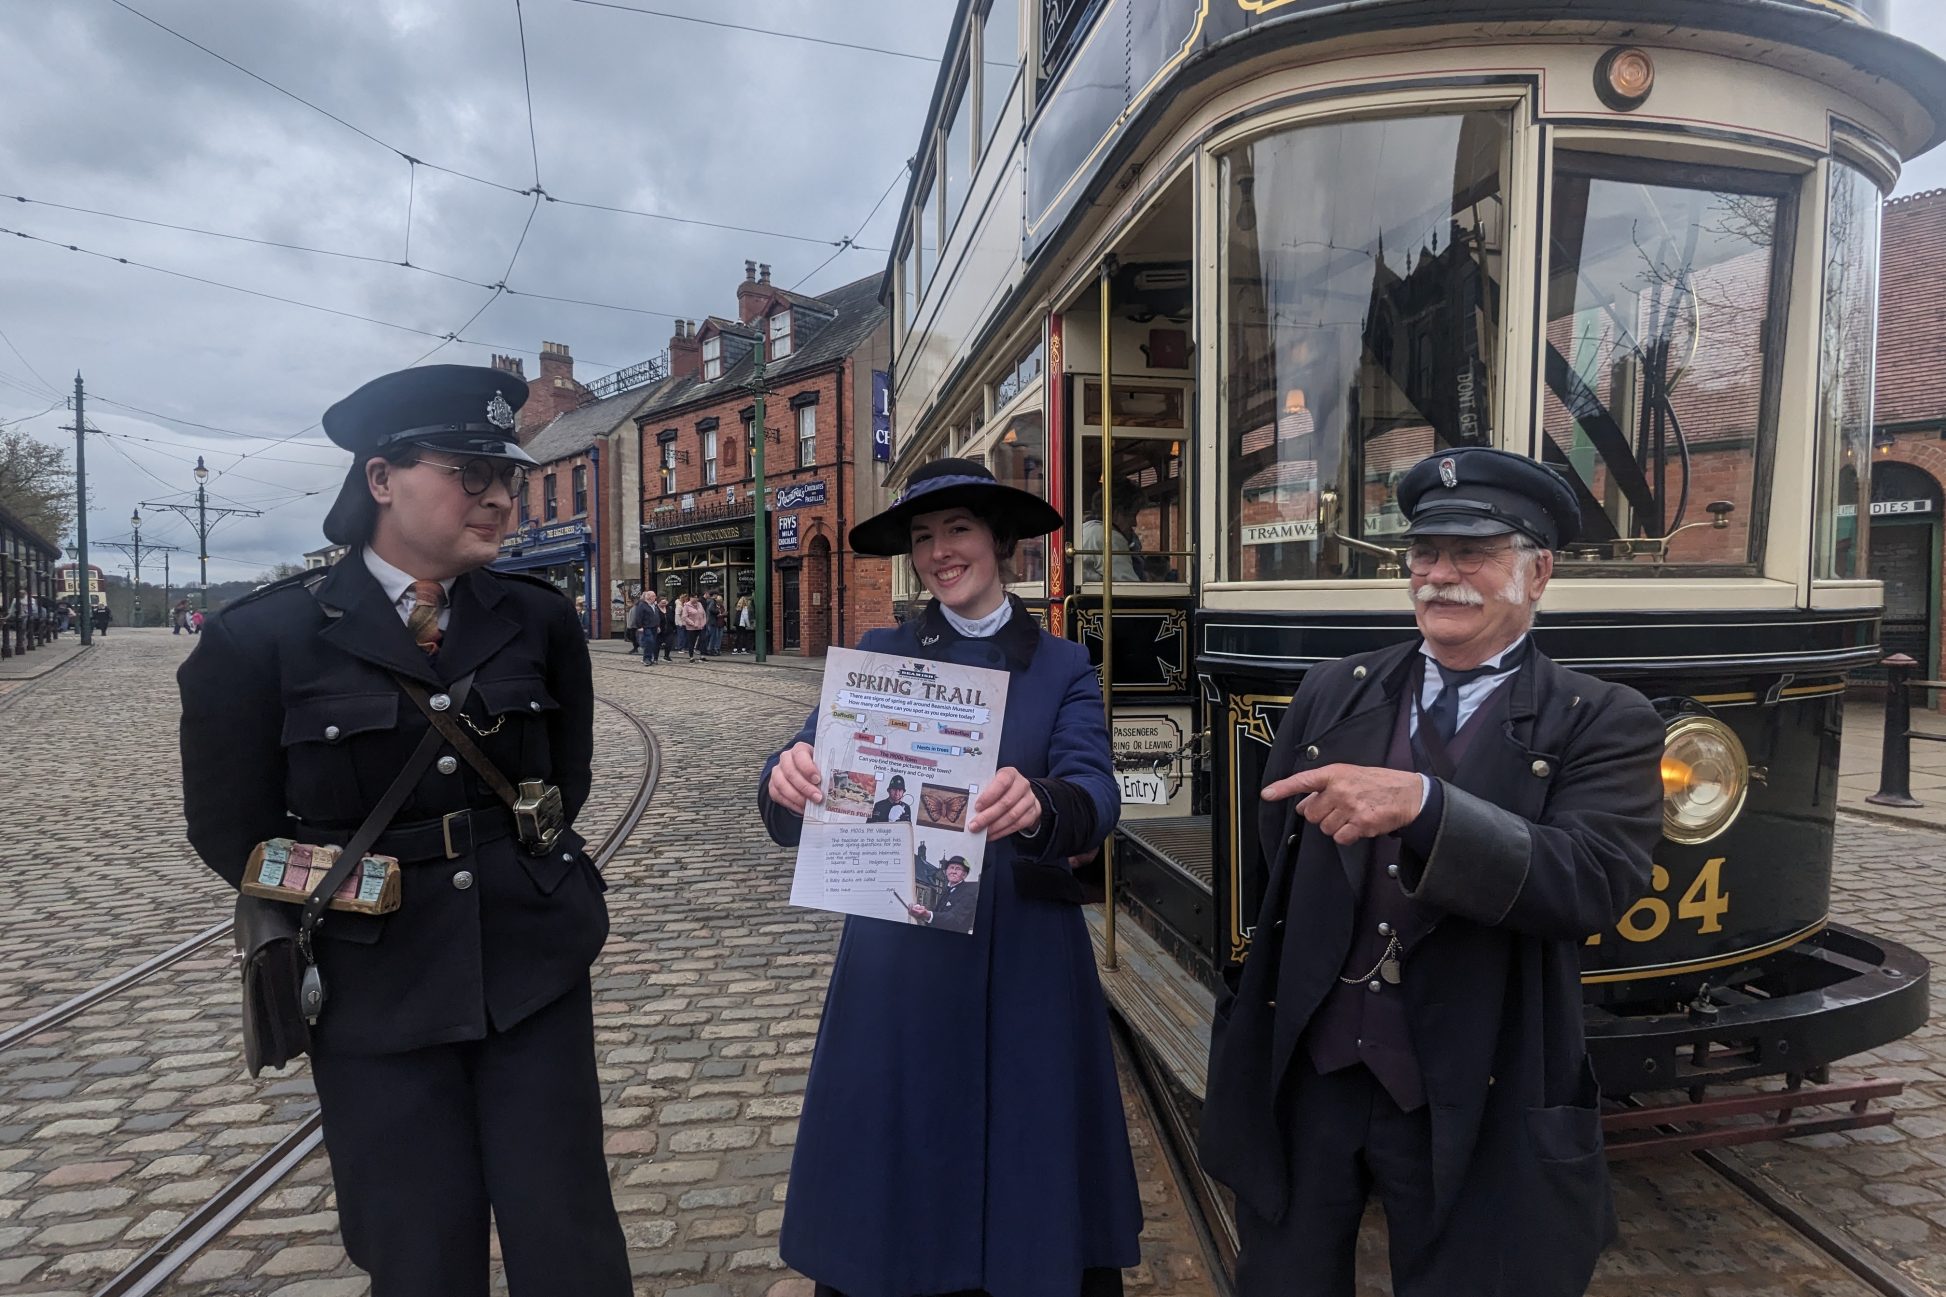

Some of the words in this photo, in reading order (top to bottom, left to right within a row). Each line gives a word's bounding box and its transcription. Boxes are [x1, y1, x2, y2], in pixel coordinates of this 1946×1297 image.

[778, 536, 797, 545] CHOCOLATE
[846, 672, 913, 696] SPRING
[922, 681, 987, 707] TRAIL
[849, 692, 863, 700] There
[891, 698, 906, 706] spring
[931, 703, 951, 711] Beamish
[952, 705, 975, 714] Museum!
[833, 710, 855, 720] Daffodils
[940, 711, 958, 719] explore
[959, 713, 975, 721] today?
[1113, 727, 1158, 737] PASSENGERS
[916, 744, 931, 752] Nests
[1133, 740, 1142, 750] OR
[1144, 740, 1173, 750] LEAVING
[890, 752, 904, 761] 1900s
[905, 755, 918, 763] Town
[873, 764, 886, 772] (Hint
[890, 767, 906, 776] Bakery
[917, 771, 935, 779] Co-op)
[903, 761, 922, 770] pictures
[928, 764, 936, 772] the
[937, 766, 952, 775] town?
[1123, 775, 1158, 802] Entry
